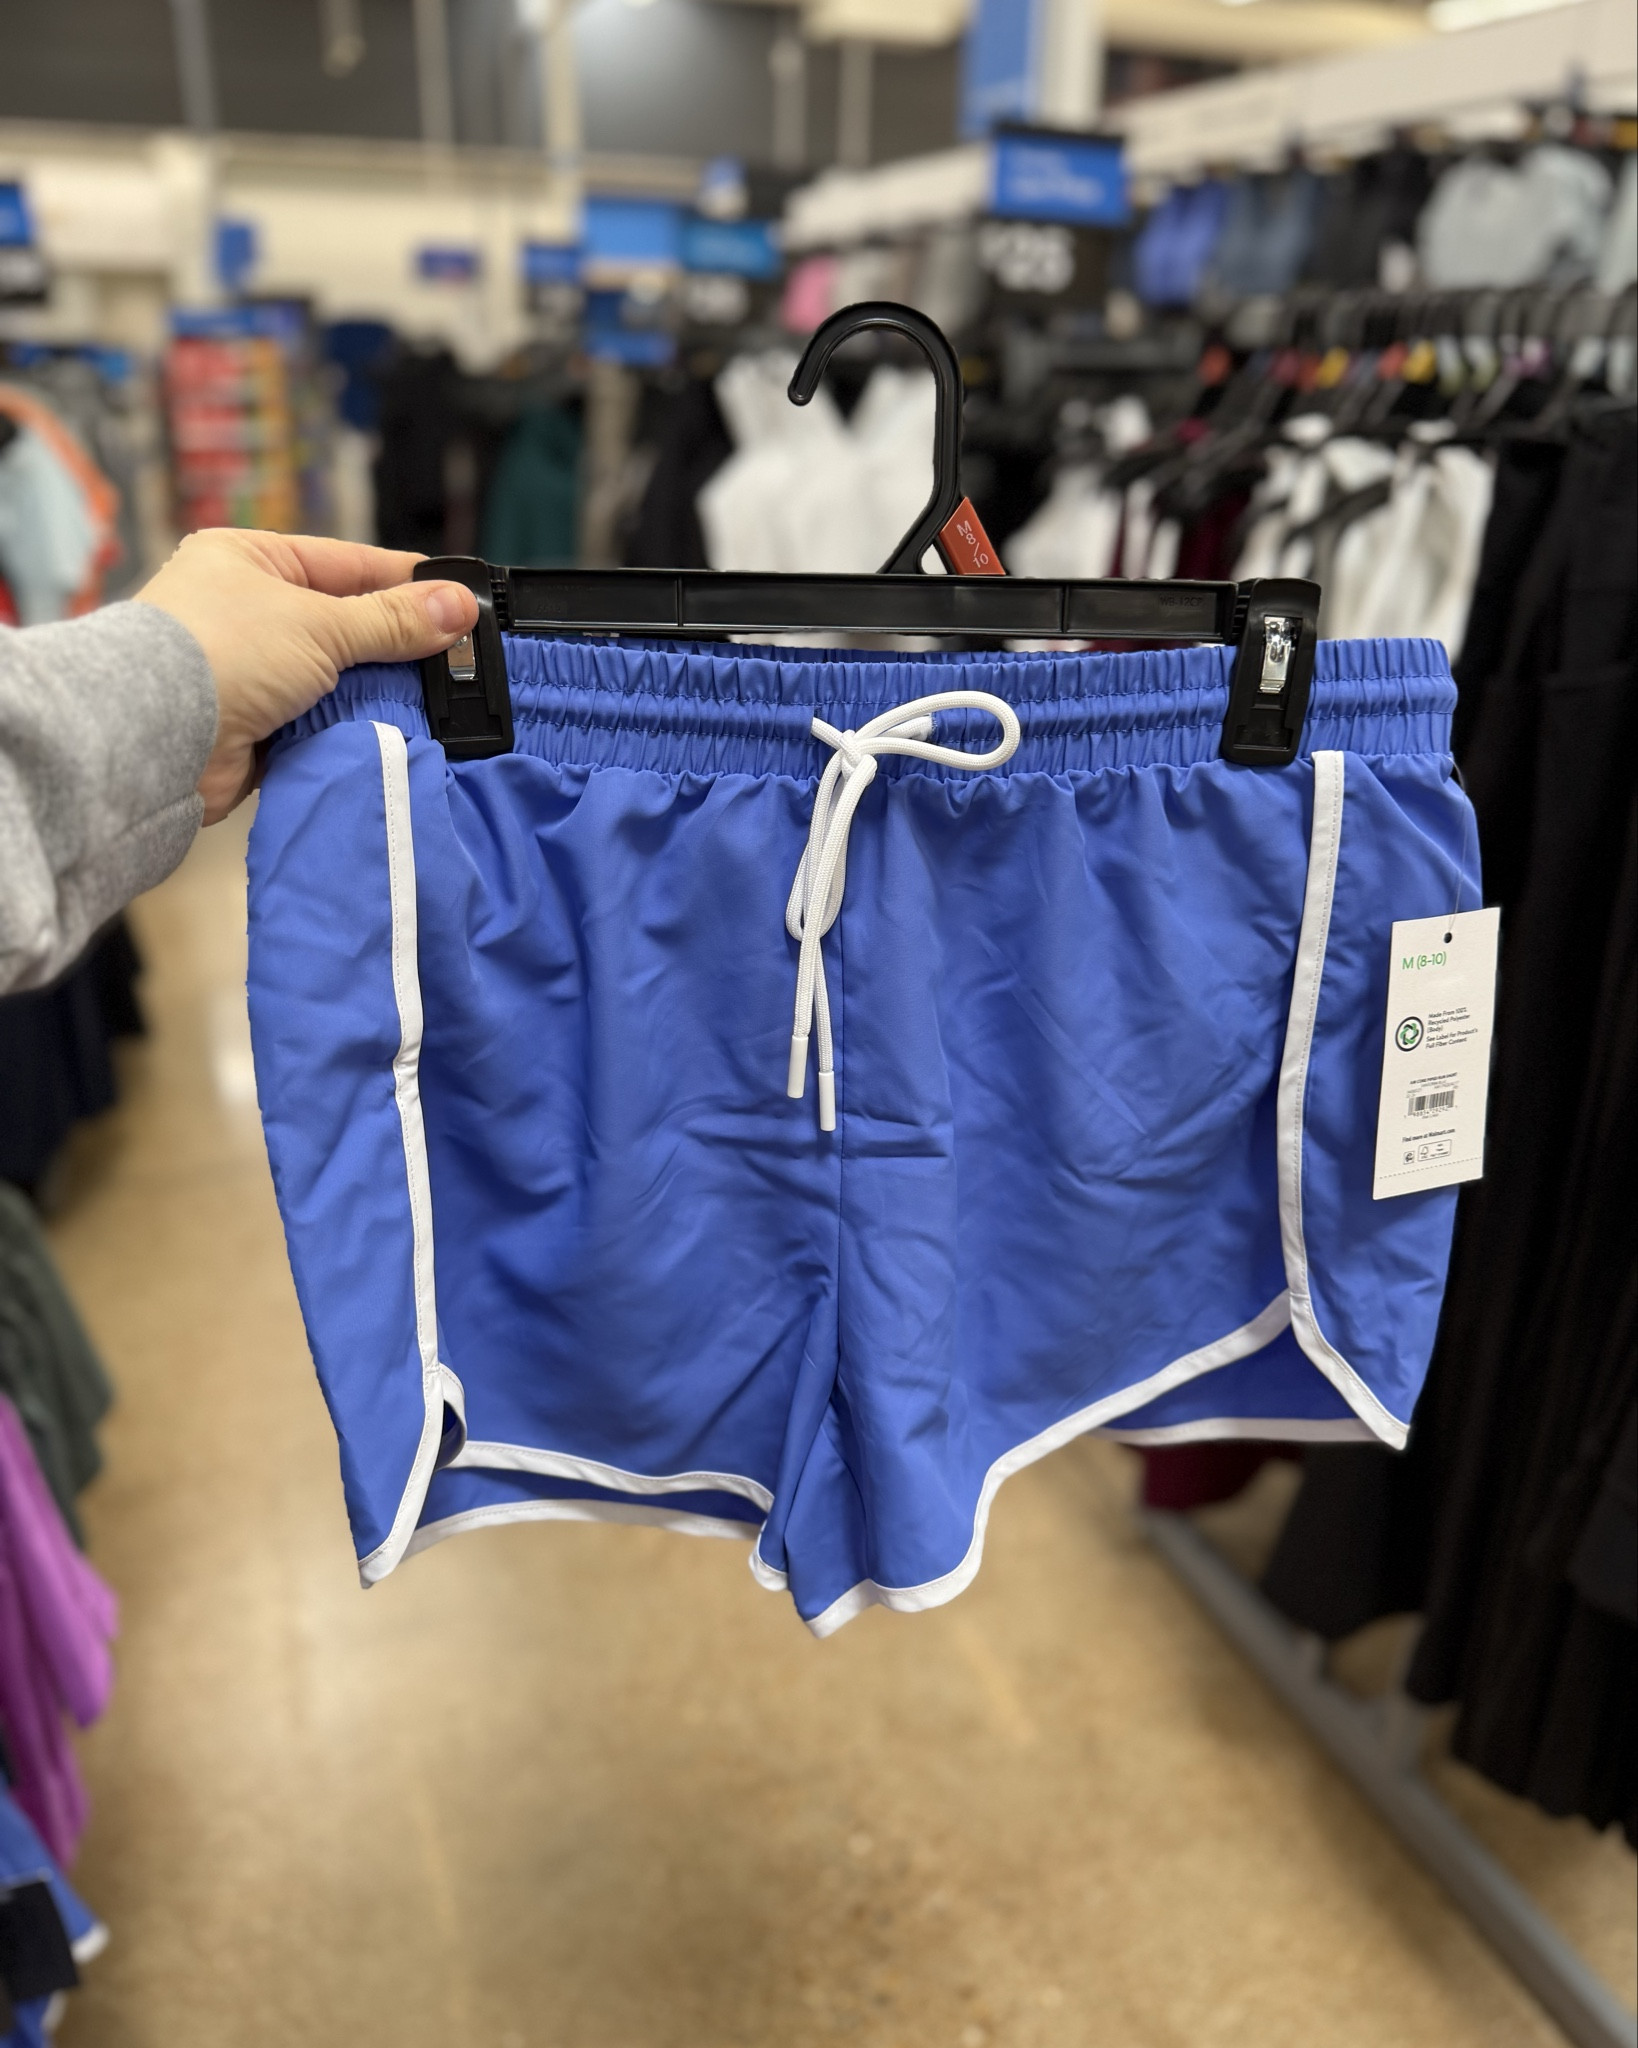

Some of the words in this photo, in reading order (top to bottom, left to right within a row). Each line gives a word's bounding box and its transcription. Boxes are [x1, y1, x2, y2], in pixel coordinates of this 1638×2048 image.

[1402, 957, 1415, 970] M
[1416, 951, 1447, 970] (8-10)
[1428, 1017, 1448, 1026] Recycled
[1450, 1014, 1470, 1022] Polyester
[1428, 1128, 1456, 1136] Walmart.com
